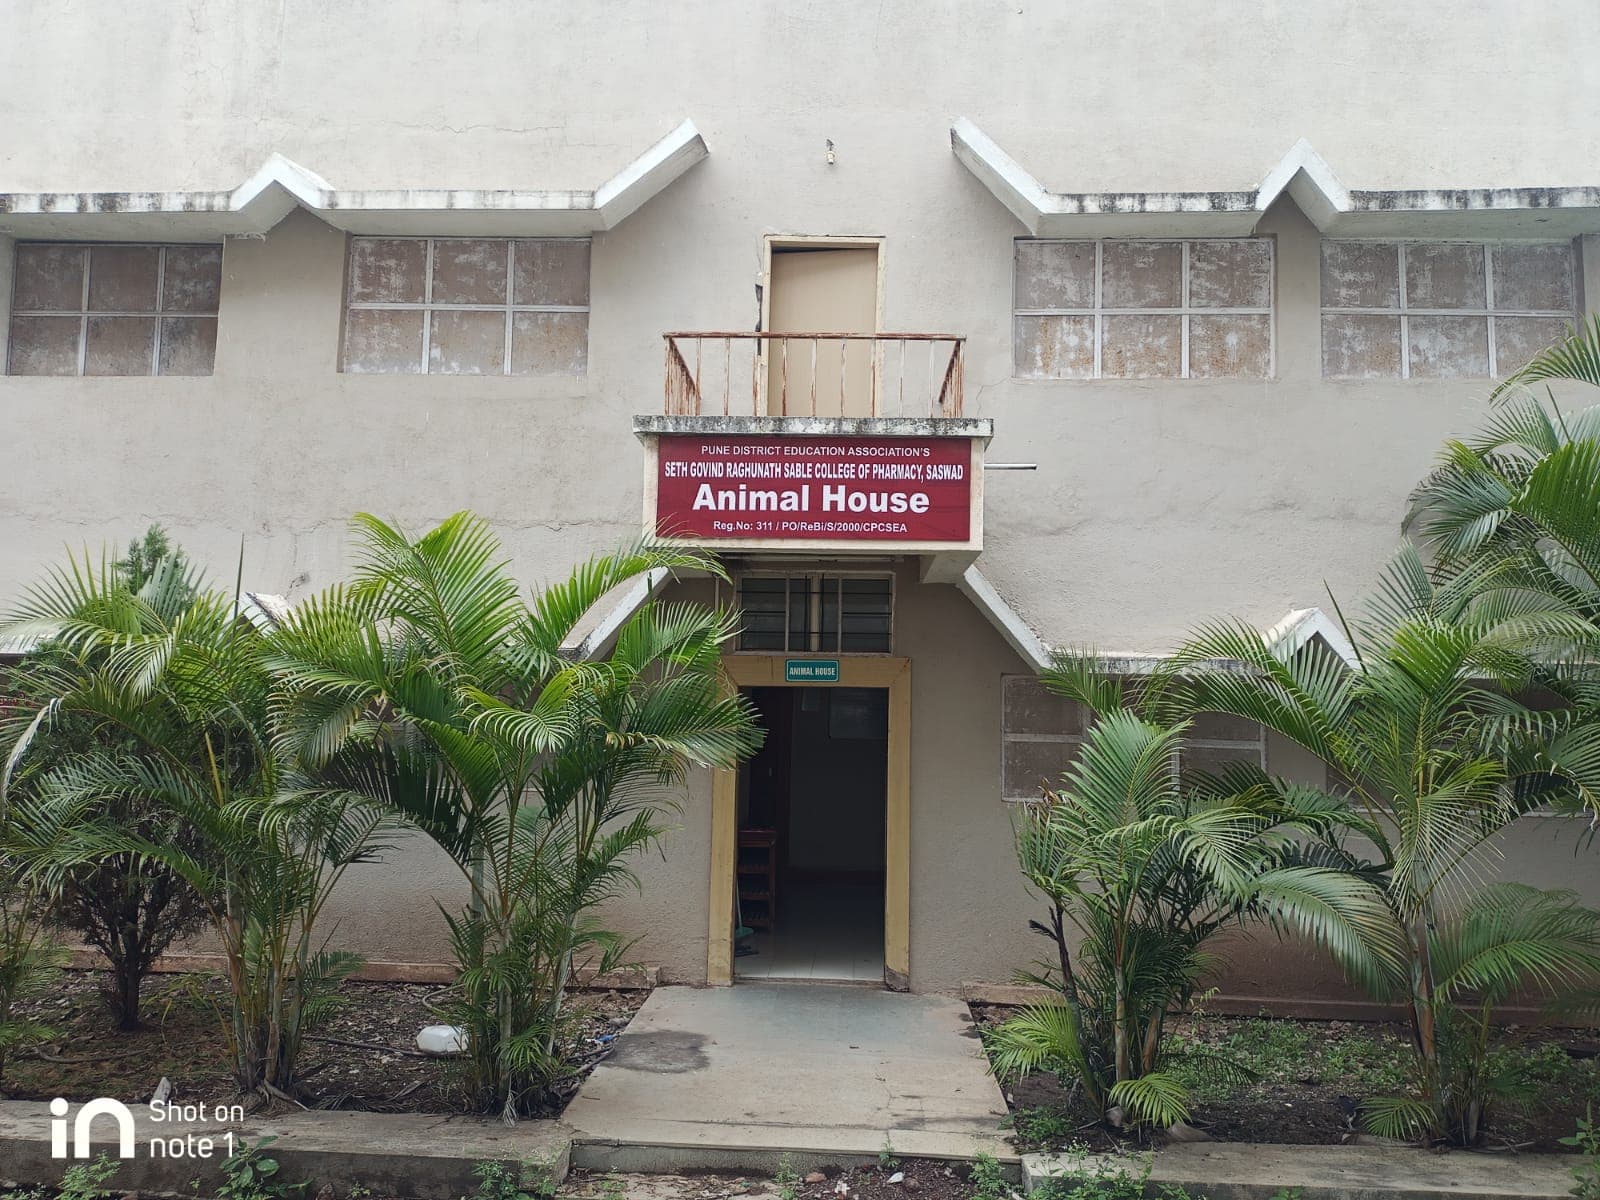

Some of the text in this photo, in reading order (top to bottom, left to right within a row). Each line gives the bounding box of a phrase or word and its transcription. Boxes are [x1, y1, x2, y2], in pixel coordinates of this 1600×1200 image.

[701, 445, 931, 457] PUNE DISTRICT EDUCATION ASSOCIATION'S
[664, 461, 964, 484] SETH GOVIND RAGHUNATH SABLE COLLEGE OF PHARMACY, SASWAD
[692, 483, 930, 514] Animal House
[713, 520, 753, 532] Reg.No:
[756, 521, 774, 531] 311
[789, 667, 836, 676] ANIMAL HOUSE
